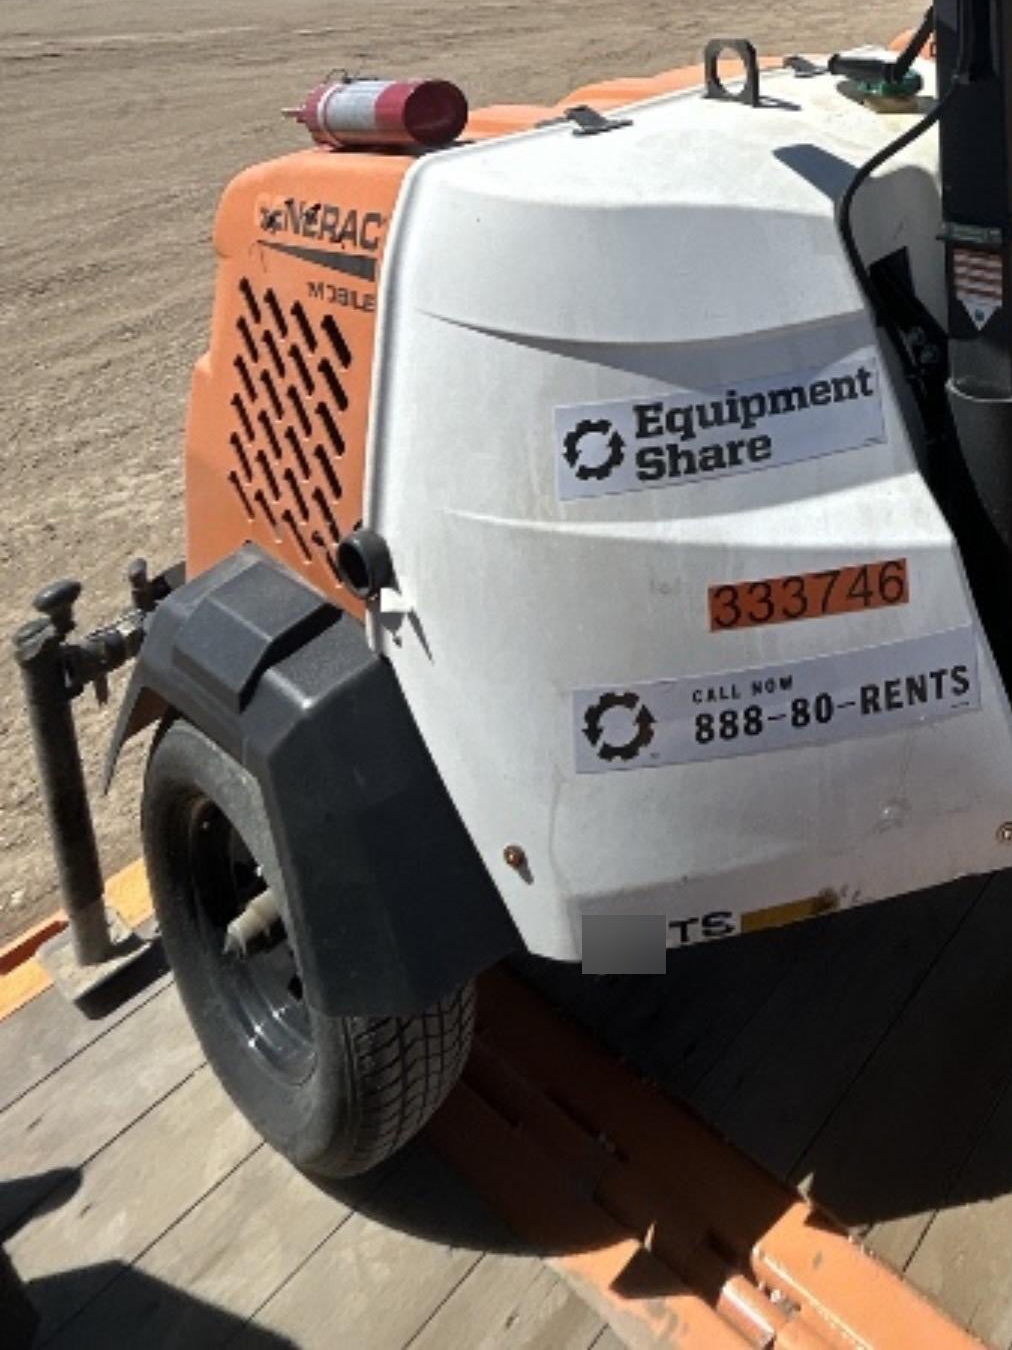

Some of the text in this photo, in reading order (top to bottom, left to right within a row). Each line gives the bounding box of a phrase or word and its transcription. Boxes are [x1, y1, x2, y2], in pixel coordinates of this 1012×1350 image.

[633, 366, 873, 441] Equipment
[636, 435, 772, 481] Share
[712, 560, 905, 628] 333746
[692, 675, 793, 704] CALL NOW
[695, 665, 970, 744] 888-80-RENTS
